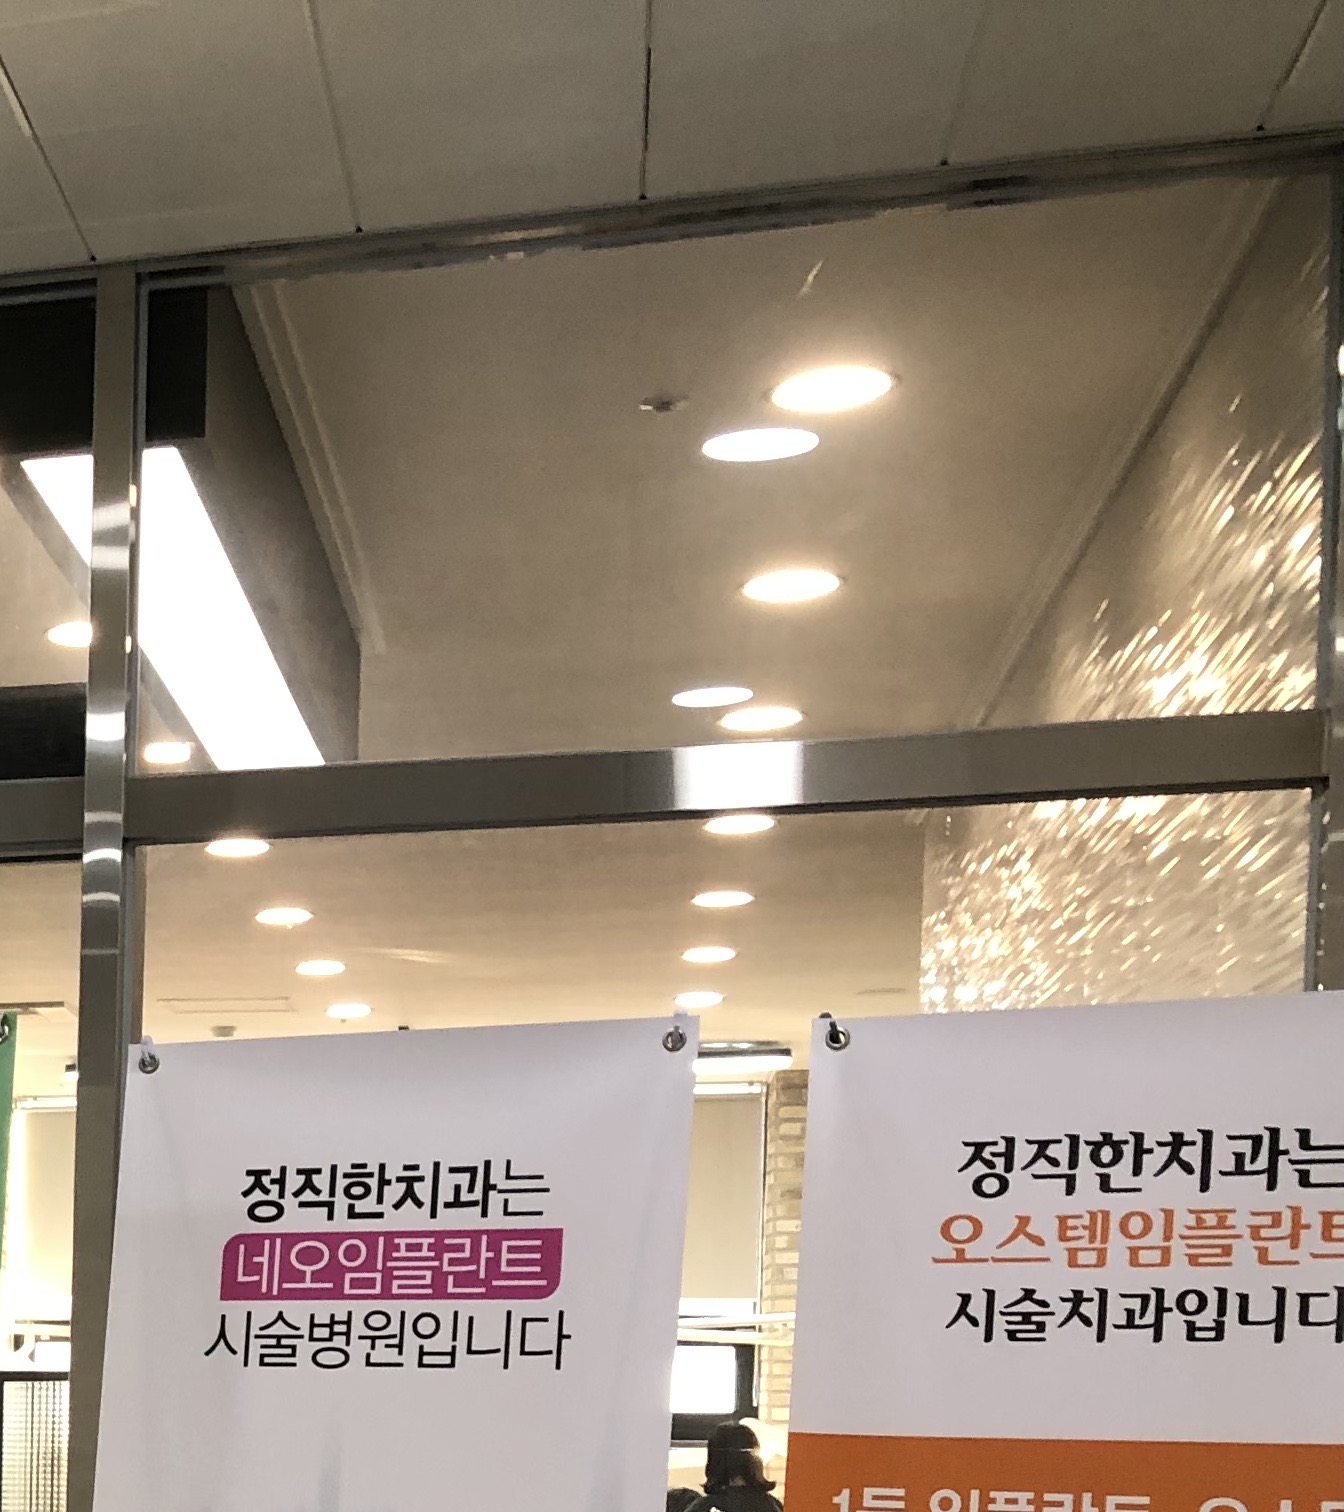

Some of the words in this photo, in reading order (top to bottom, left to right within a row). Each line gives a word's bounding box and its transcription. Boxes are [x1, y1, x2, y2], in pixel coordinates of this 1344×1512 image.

[240, 1159, 550, 1223] 정직한치과는
[957, 1126, 1344, 1198] 정직한치과는
[236, 1235, 548, 1295] 네오임플란트
[204, 1309, 571, 1370] 시술병원입니다
[945, 1285, 1344, 1344] 시술치과입니다
